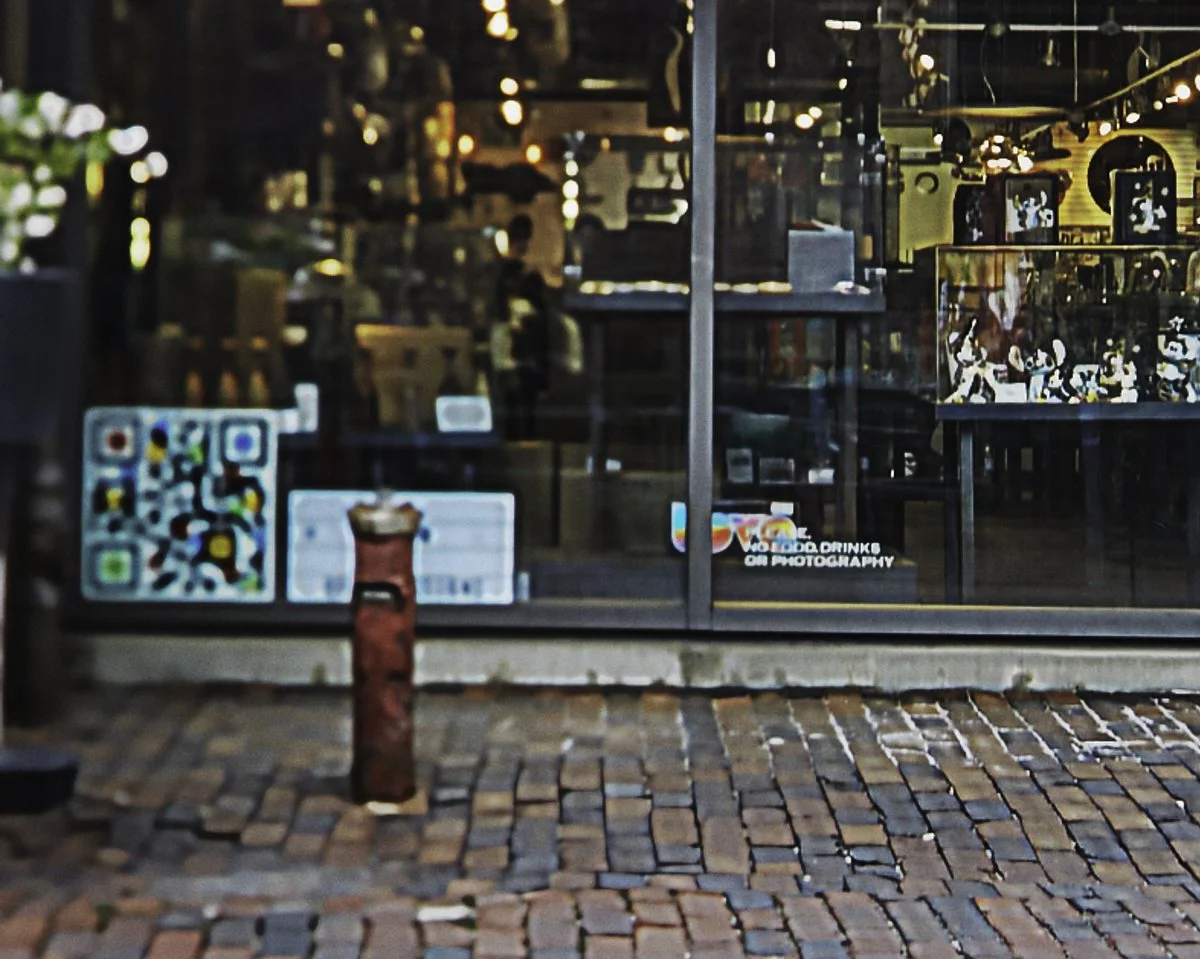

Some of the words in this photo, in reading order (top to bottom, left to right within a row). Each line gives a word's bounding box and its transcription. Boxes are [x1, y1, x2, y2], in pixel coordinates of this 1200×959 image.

[820, 541, 882, 555] DRINKS
[744, 554, 768, 567] OR
[771, 554, 895, 568] PHOTOGRAPHY
